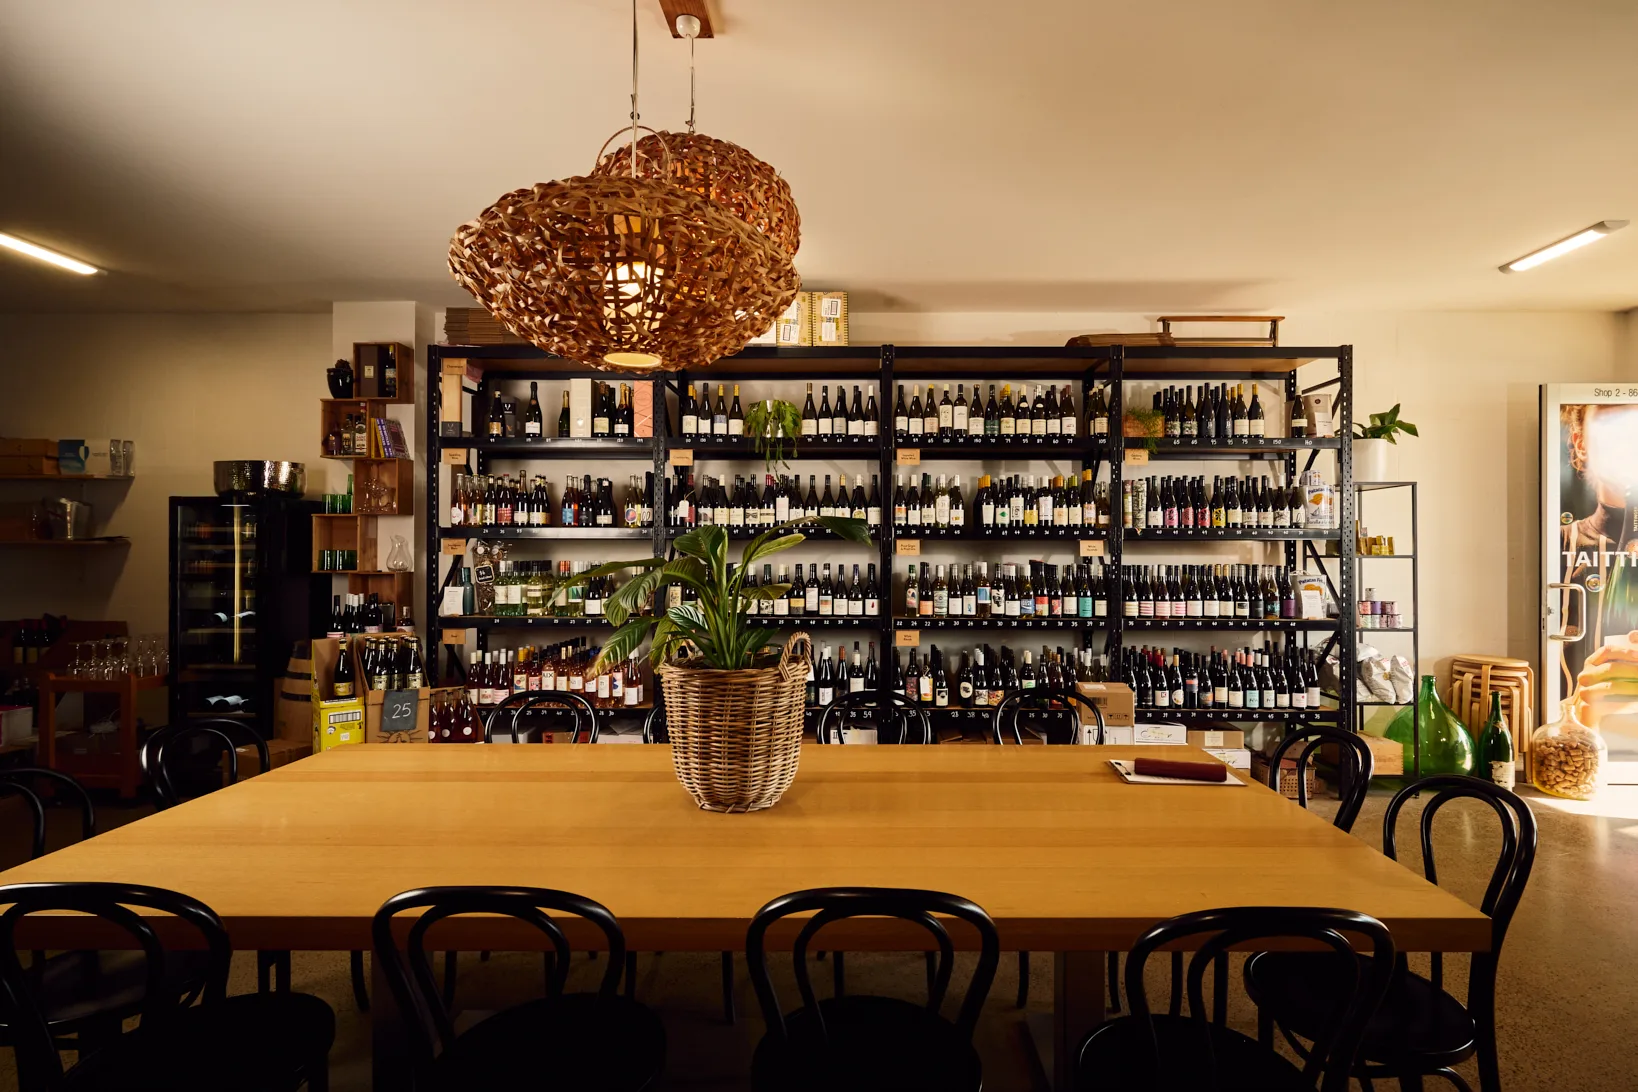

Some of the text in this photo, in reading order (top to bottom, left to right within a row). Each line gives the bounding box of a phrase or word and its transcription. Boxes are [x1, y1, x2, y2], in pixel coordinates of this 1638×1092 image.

[1594, 388, 1612, 398] Shop
[1615, 388, 1620, 397] 2
[1562, 552, 1636, 567] TAITTI
[392, 702, 412, 719] 25
